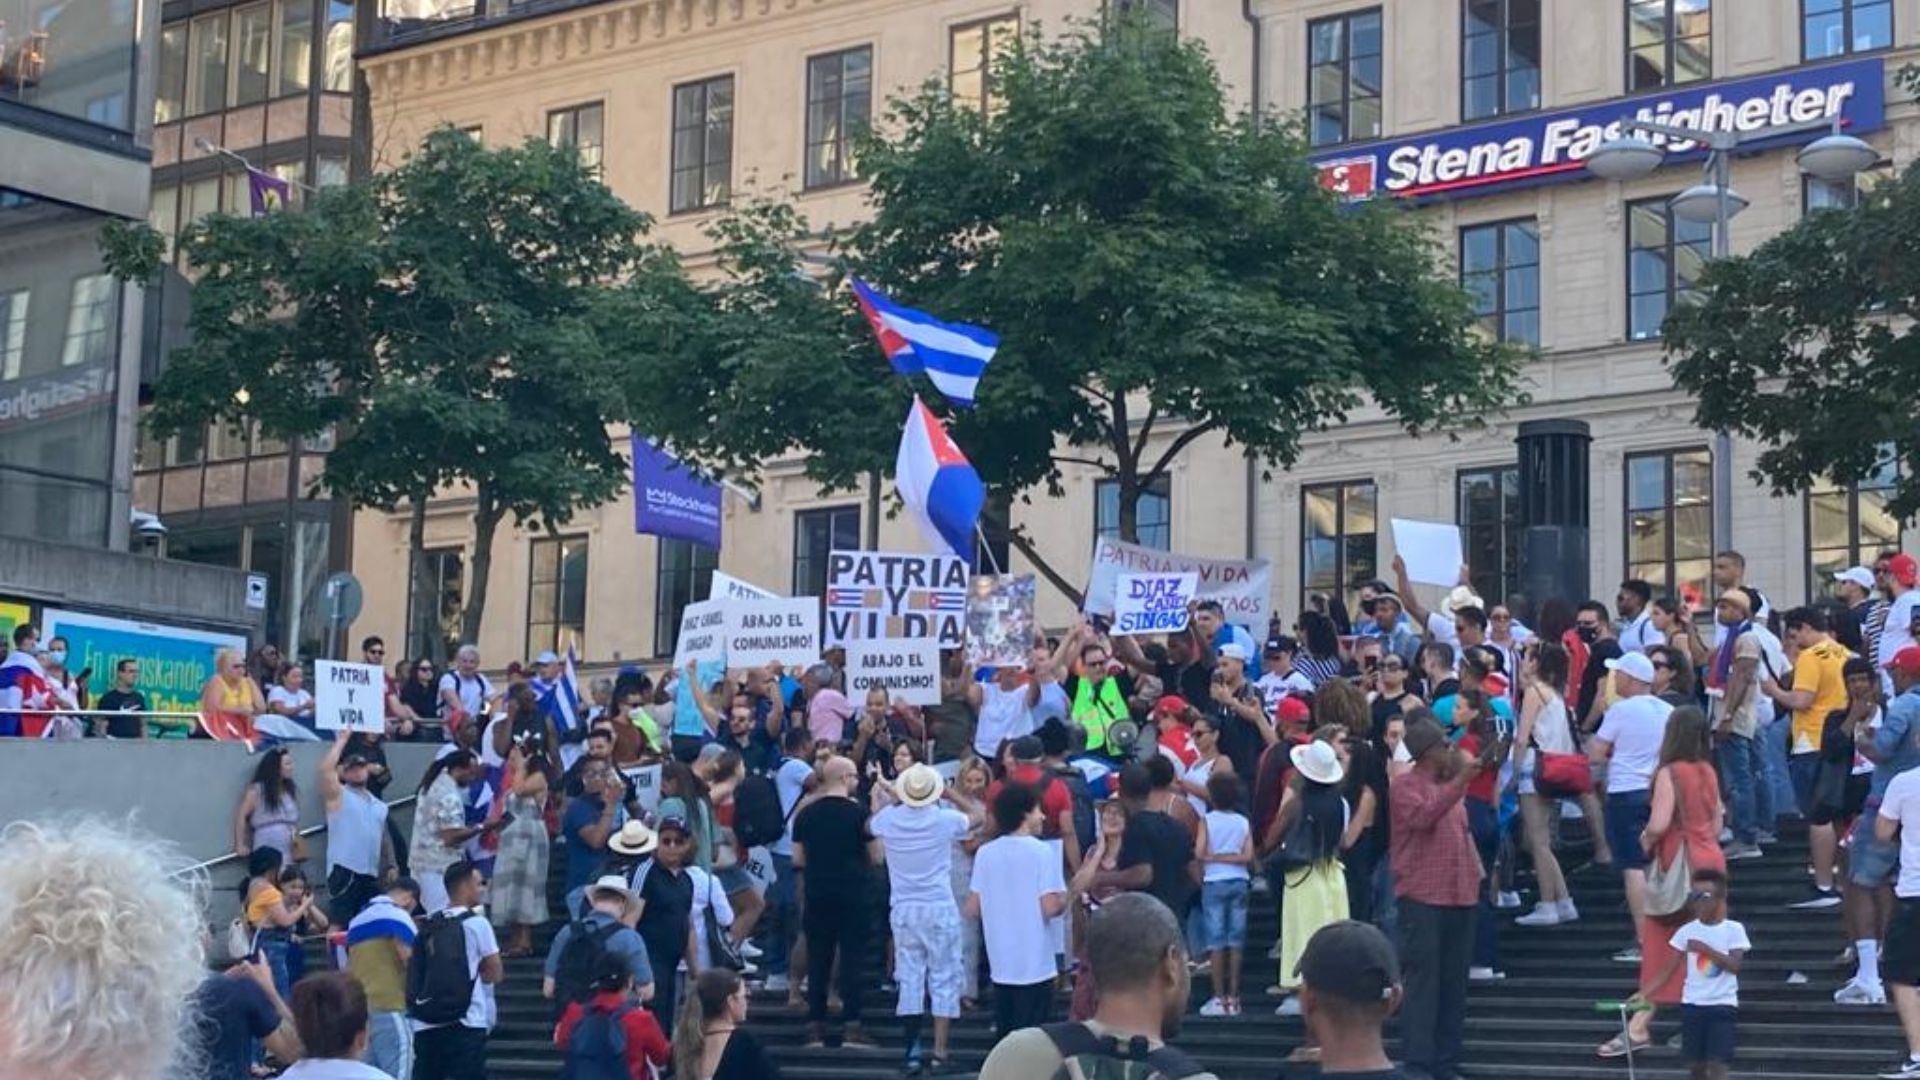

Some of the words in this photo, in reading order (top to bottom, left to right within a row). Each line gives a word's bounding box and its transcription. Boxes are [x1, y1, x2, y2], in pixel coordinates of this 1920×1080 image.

[1384, 137, 1535, 191] Stena
[829, 554, 967, 588] PATRIA
[1099, 543, 1171, 573] PATRIA
[1200, 563, 1249, 582] VIDA
[1128, 578, 1181, 599] DIAZ
[886, 586, 909, 616] Y
[741, 614, 783, 629] ABAJO
[788, 613, 804, 627] EL
[829, 611, 961, 644] VIDA
[733, 634, 813, 651] COMUNISMO!
[862, 654, 903, 668] ABAJO
[909, 654, 924, 667] EL
[331, 666, 370, 685] PATRIA
[853, 674, 934, 690] COMUNISMO!
[347, 688, 355, 704] Y
[339, 708, 364, 725] VIDA
